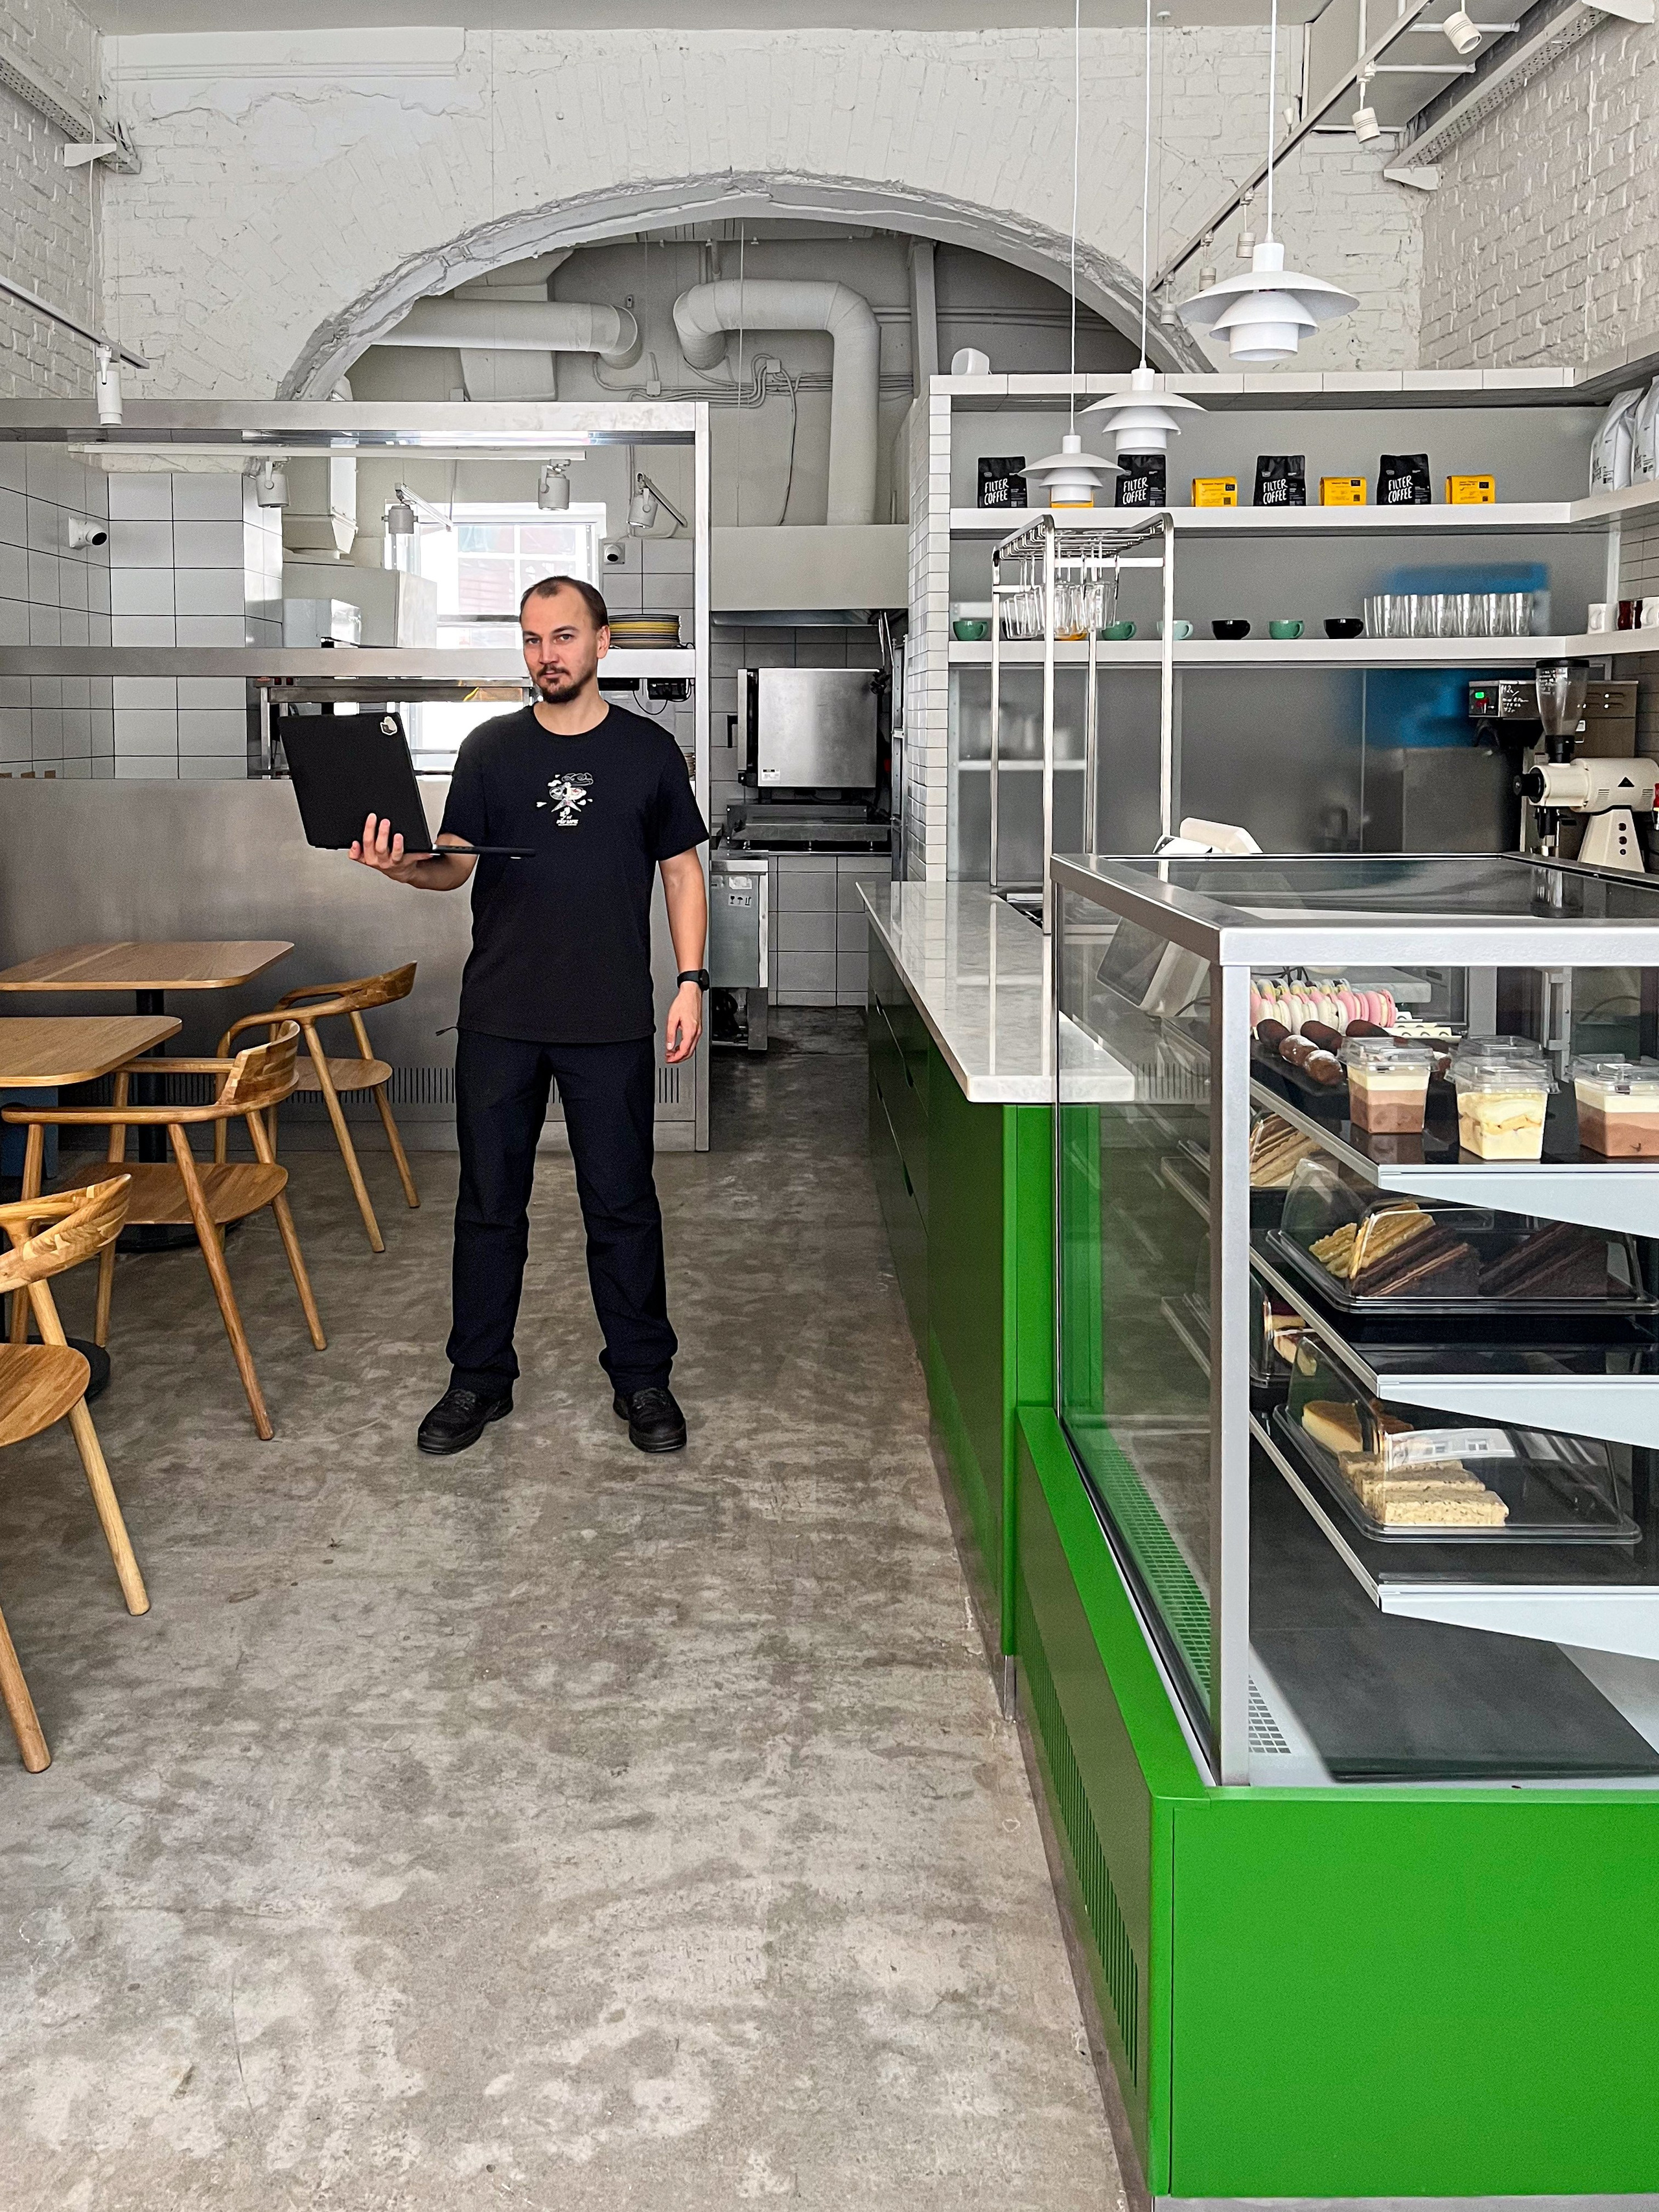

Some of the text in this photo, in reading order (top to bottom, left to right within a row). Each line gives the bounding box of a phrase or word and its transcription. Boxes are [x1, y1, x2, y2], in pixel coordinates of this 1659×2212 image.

[984, 478, 1009, 493] FILTER
[1123, 476, 1148, 493] FILTER
[1263, 478, 1288, 493] FILTER
[1388, 475, 1413, 491] FILTER
[984, 489, 1008, 506] COFFEE
[1122, 488, 1147, 505] COFFEE
[1262, 488, 1287, 505] COFFEE
[1388, 486, 1413, 504] COFFEE
